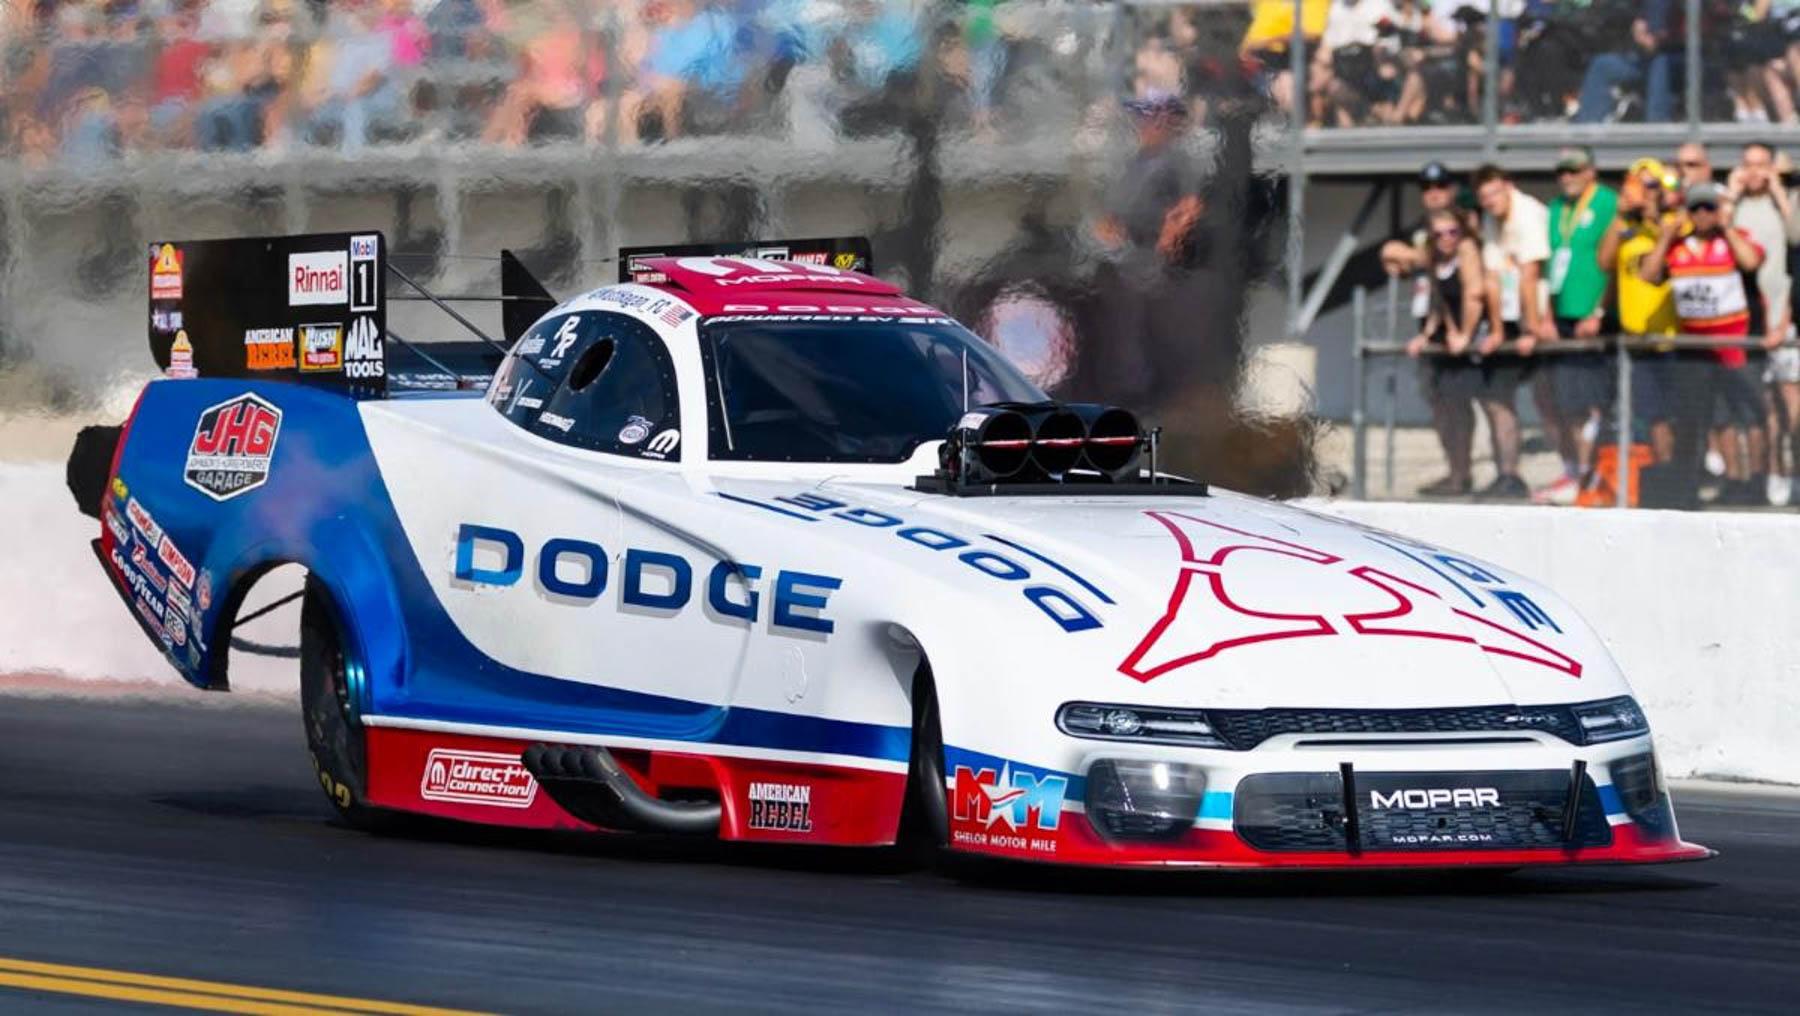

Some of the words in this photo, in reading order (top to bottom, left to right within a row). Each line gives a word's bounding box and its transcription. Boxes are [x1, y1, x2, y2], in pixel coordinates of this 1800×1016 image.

[352, 241, 376, 256] Mobil
[295, 263, 343, 293] Rinnai
[357, 262, 368, 303] 1
[715, 274, 865, 288] MOPAR
[245, 328, 294, 345] AMERICAN
[345, 316, 384, 360] MAC
[345, 361, 384, 378] TOOLS
[195, 402, 278, 457] JHG
[195, 471, 253, 492] GARAGE
[775, 493, 1103, 633] DODGE
[111, 548, 166, 619] GOODYEAR
[456, 523, 843, 634] DODGE
[453, 761, 513, 784] direct
[749, 782, 811, 803] AMERICAN
[1370, 787, 1501, 810] MOPAR
[749, 801, 812, 832] REBEL
[954, 830, 987, 845] SHELOR
[991, 834, 1027, 849] MOTOR
[1030, 840, 1057, 853] MILE
[1392, 834, 1494, 844] MOPAR.COM
